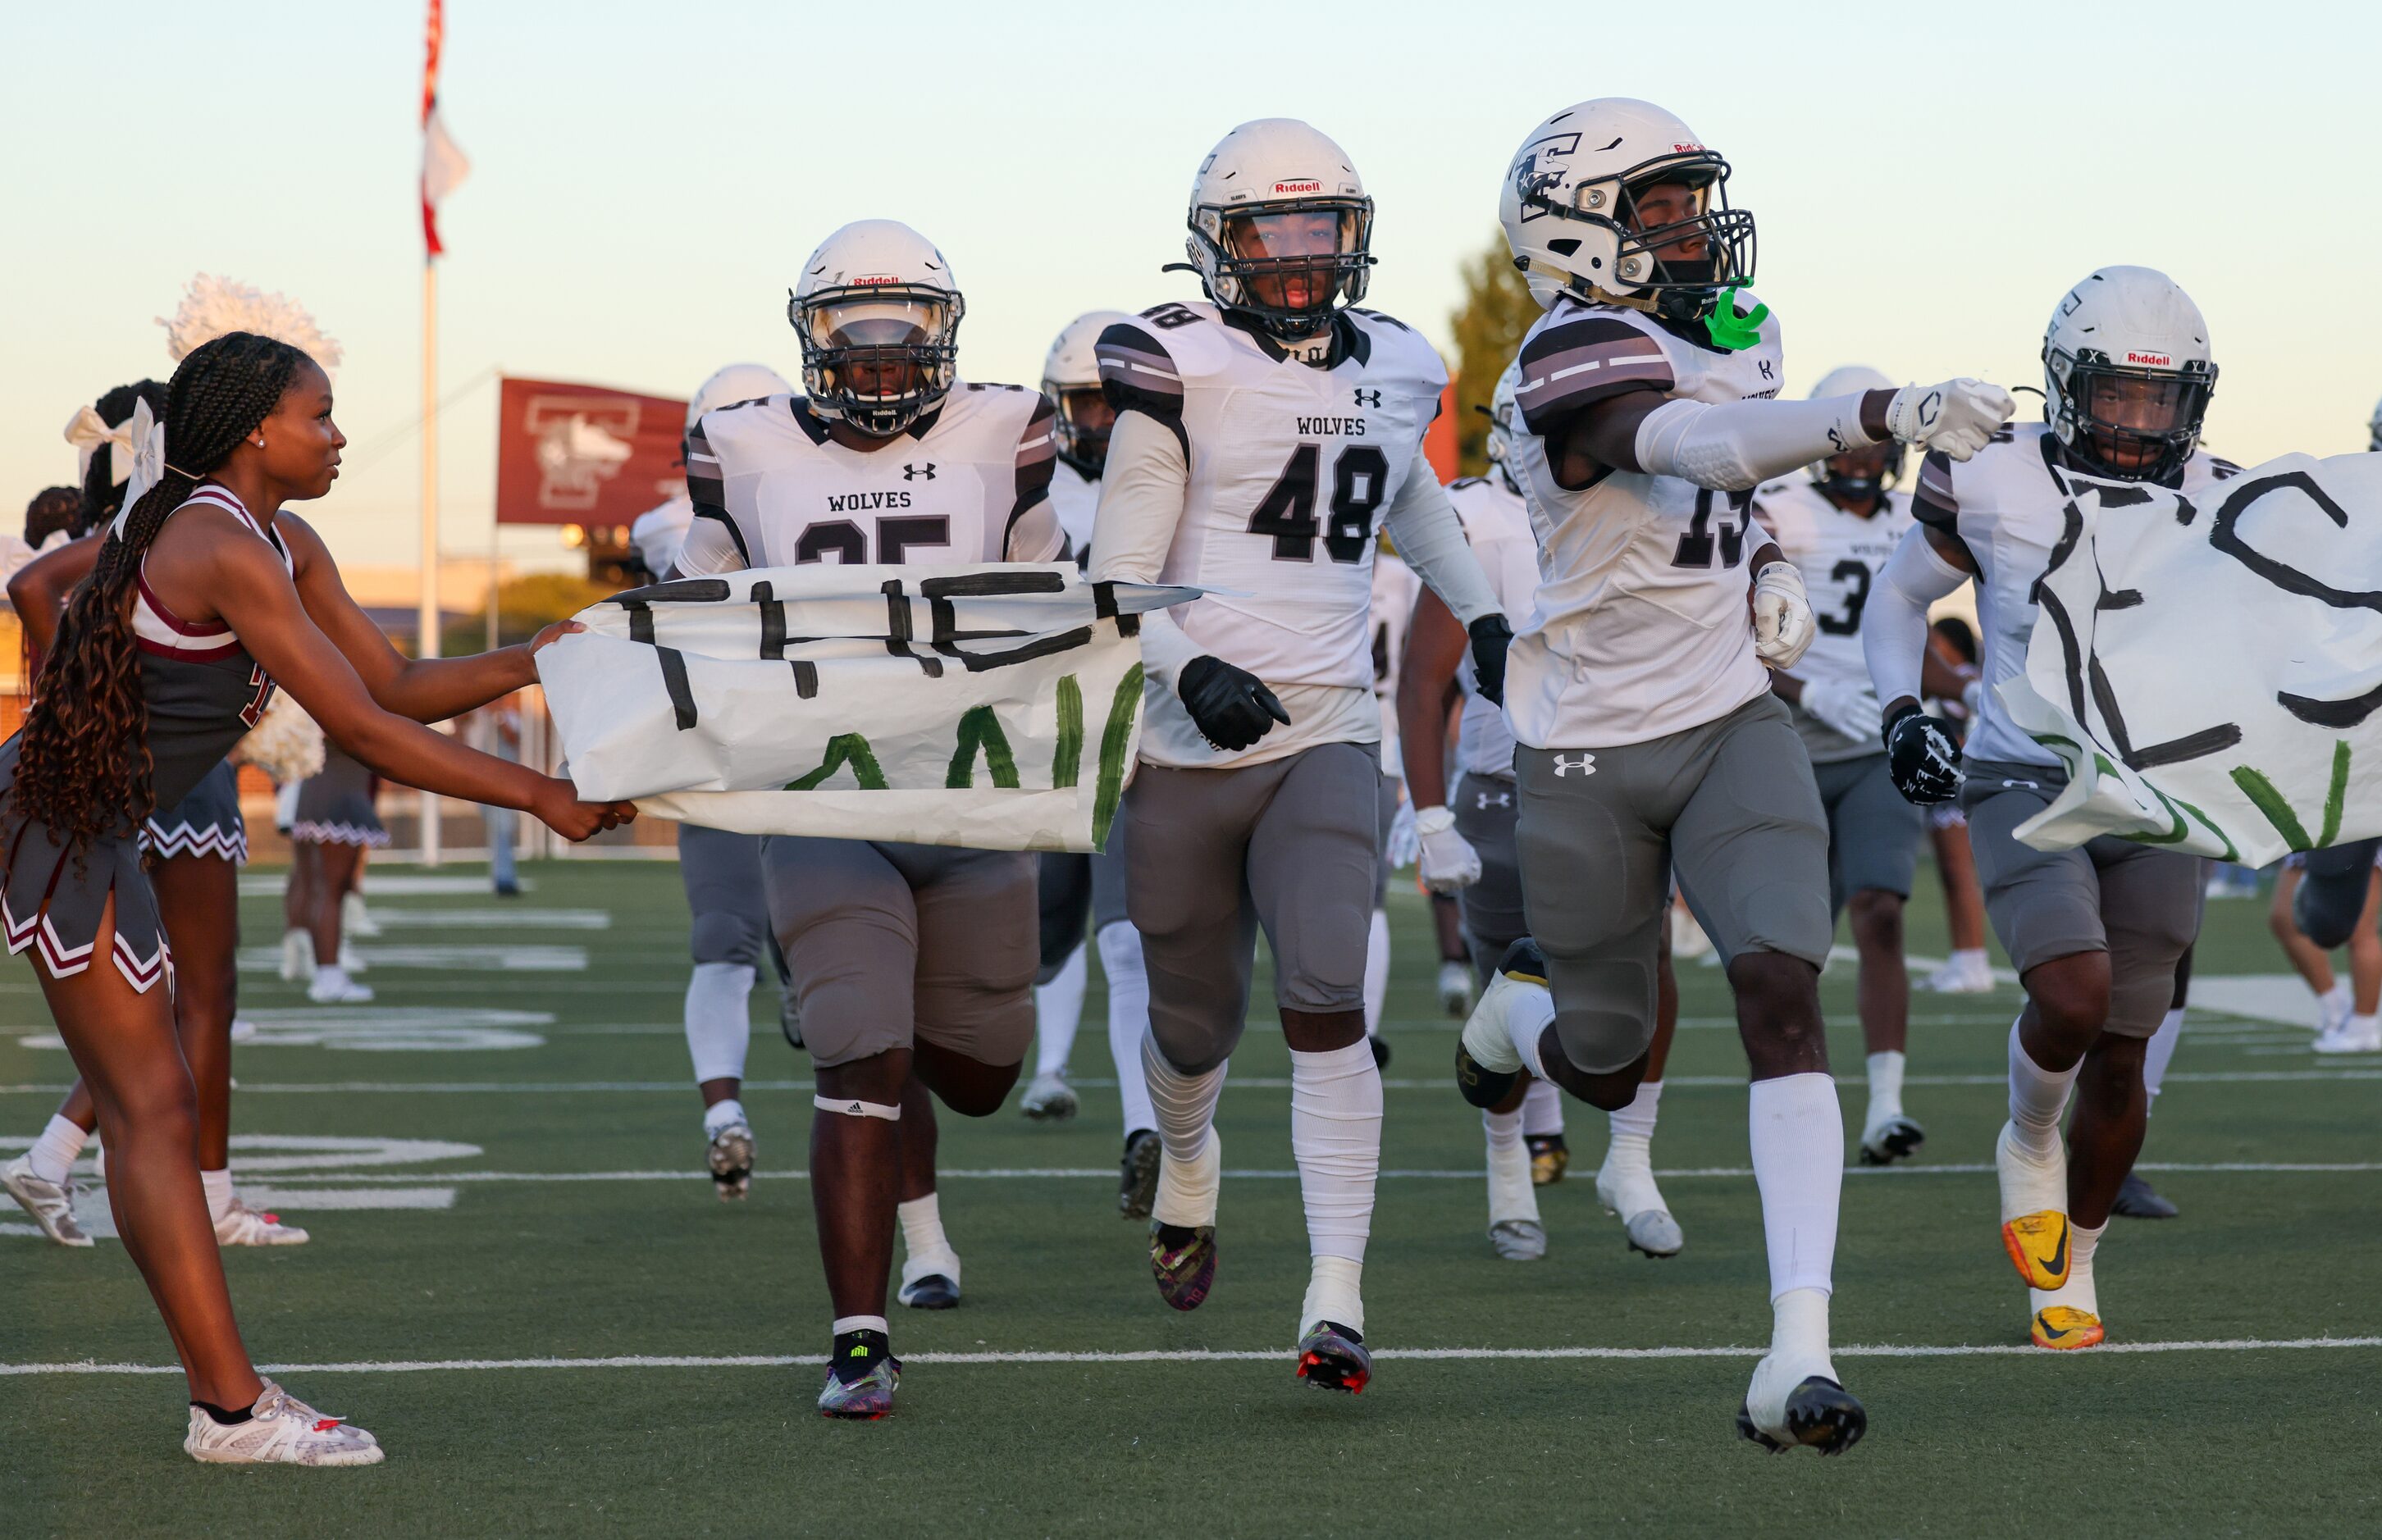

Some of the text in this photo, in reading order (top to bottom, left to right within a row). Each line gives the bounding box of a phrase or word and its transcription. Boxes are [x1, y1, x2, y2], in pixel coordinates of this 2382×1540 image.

[1275, 182, 1320, 193] Riddell
[2128, 353, 2170, 366] Riddell
[1297, 417, 1366, 436] WOLVES
[828, 491, 912, 512] WOLVES
[1246, 443, 1390, 565] 48
[1818, 559, 1885, 636] 3
